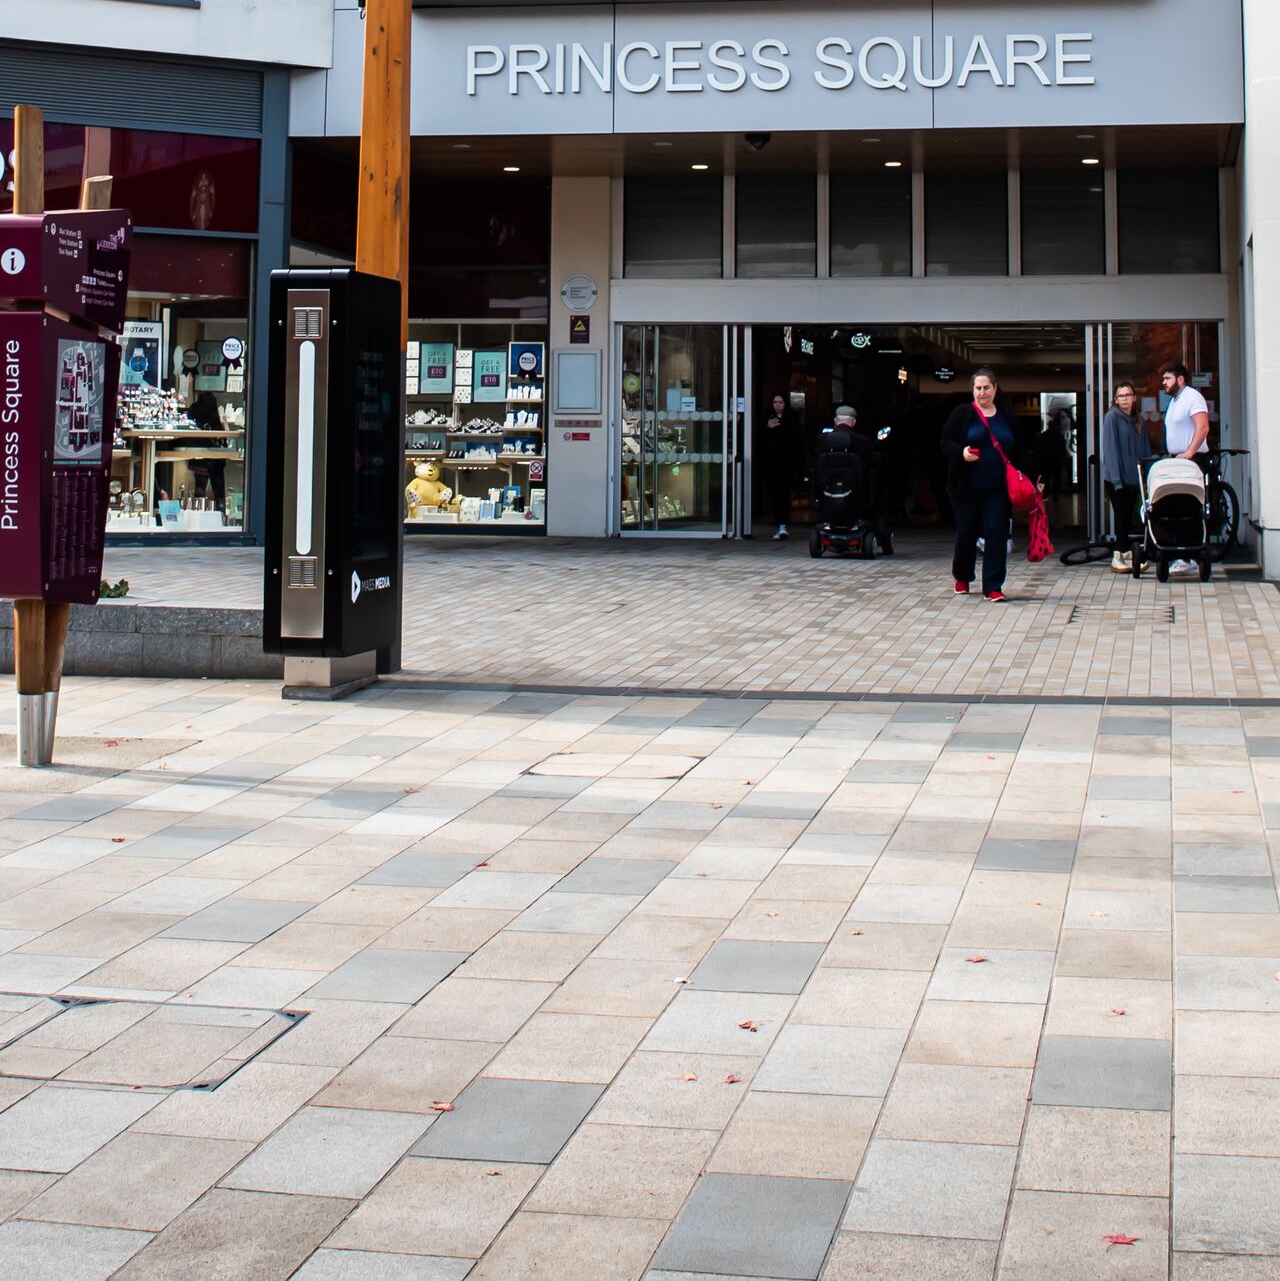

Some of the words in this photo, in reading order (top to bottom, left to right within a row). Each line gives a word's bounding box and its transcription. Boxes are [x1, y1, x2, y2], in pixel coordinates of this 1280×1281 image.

[465, 39, 791, 95] PRINCESS
[813, 32, 1096, 91] SQUARE
[2, 340, 22, 423] Square
[0, 431, 19, 530] Princess
[375, 576, 390, 590] MEDIA
